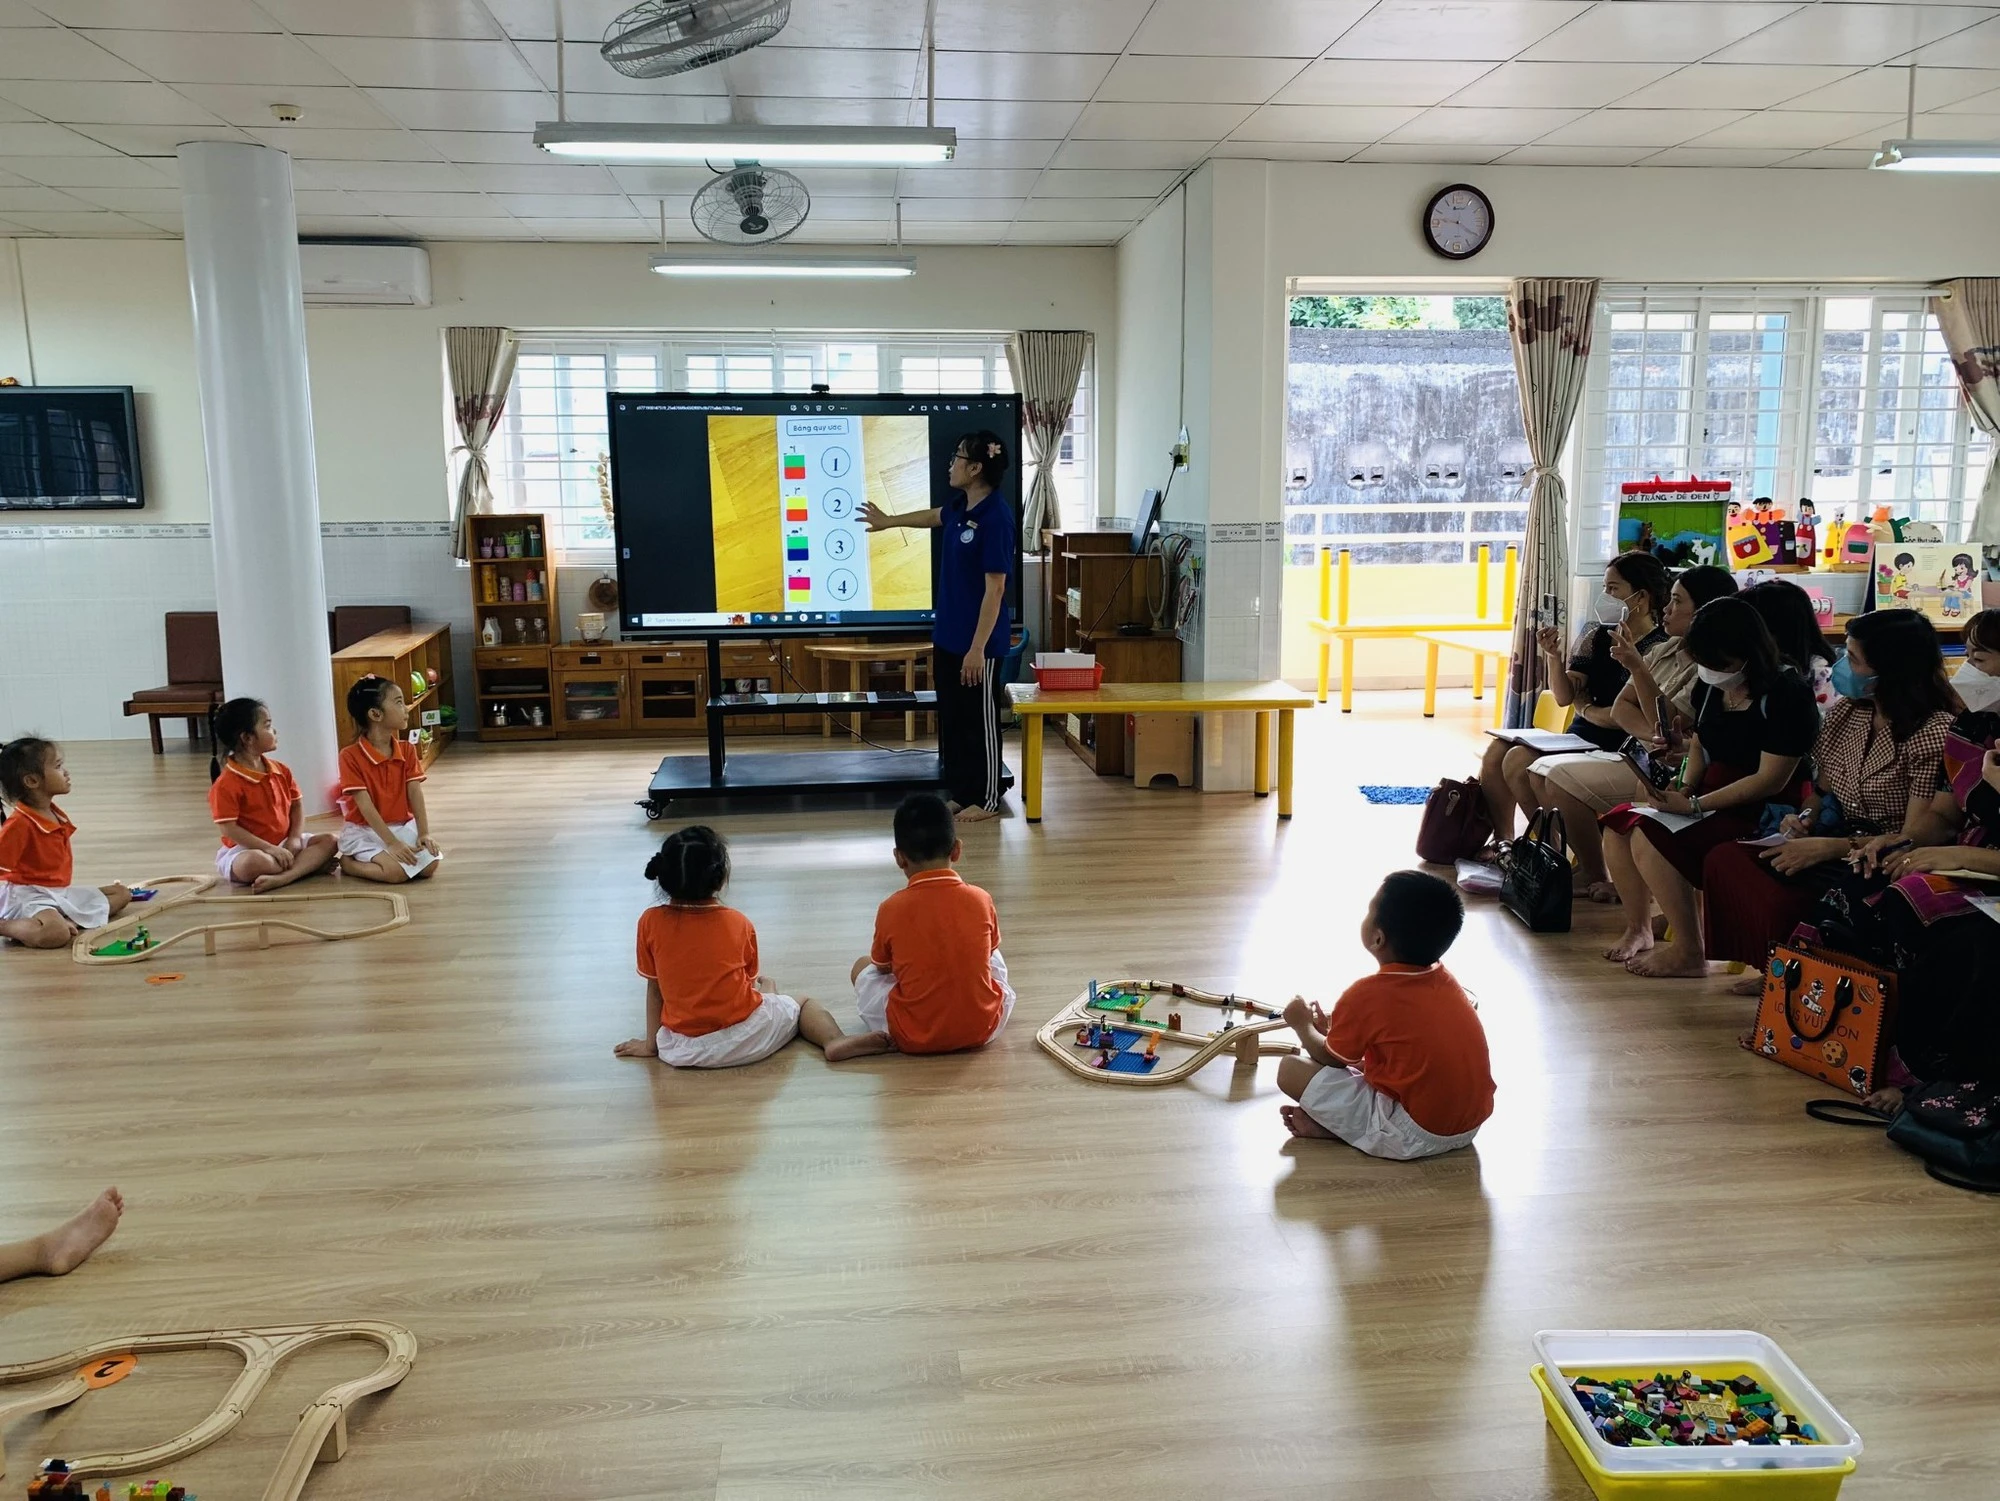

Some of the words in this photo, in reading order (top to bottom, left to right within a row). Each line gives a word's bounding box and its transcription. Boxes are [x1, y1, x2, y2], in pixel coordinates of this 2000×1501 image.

[832, 457, 839, 472] 1
[833, 498, 842, 513] 2
[835, 539, 844, 555] 3
[837, 579, 847, 595] 4
[94, 1359, 125, 1378] 2
